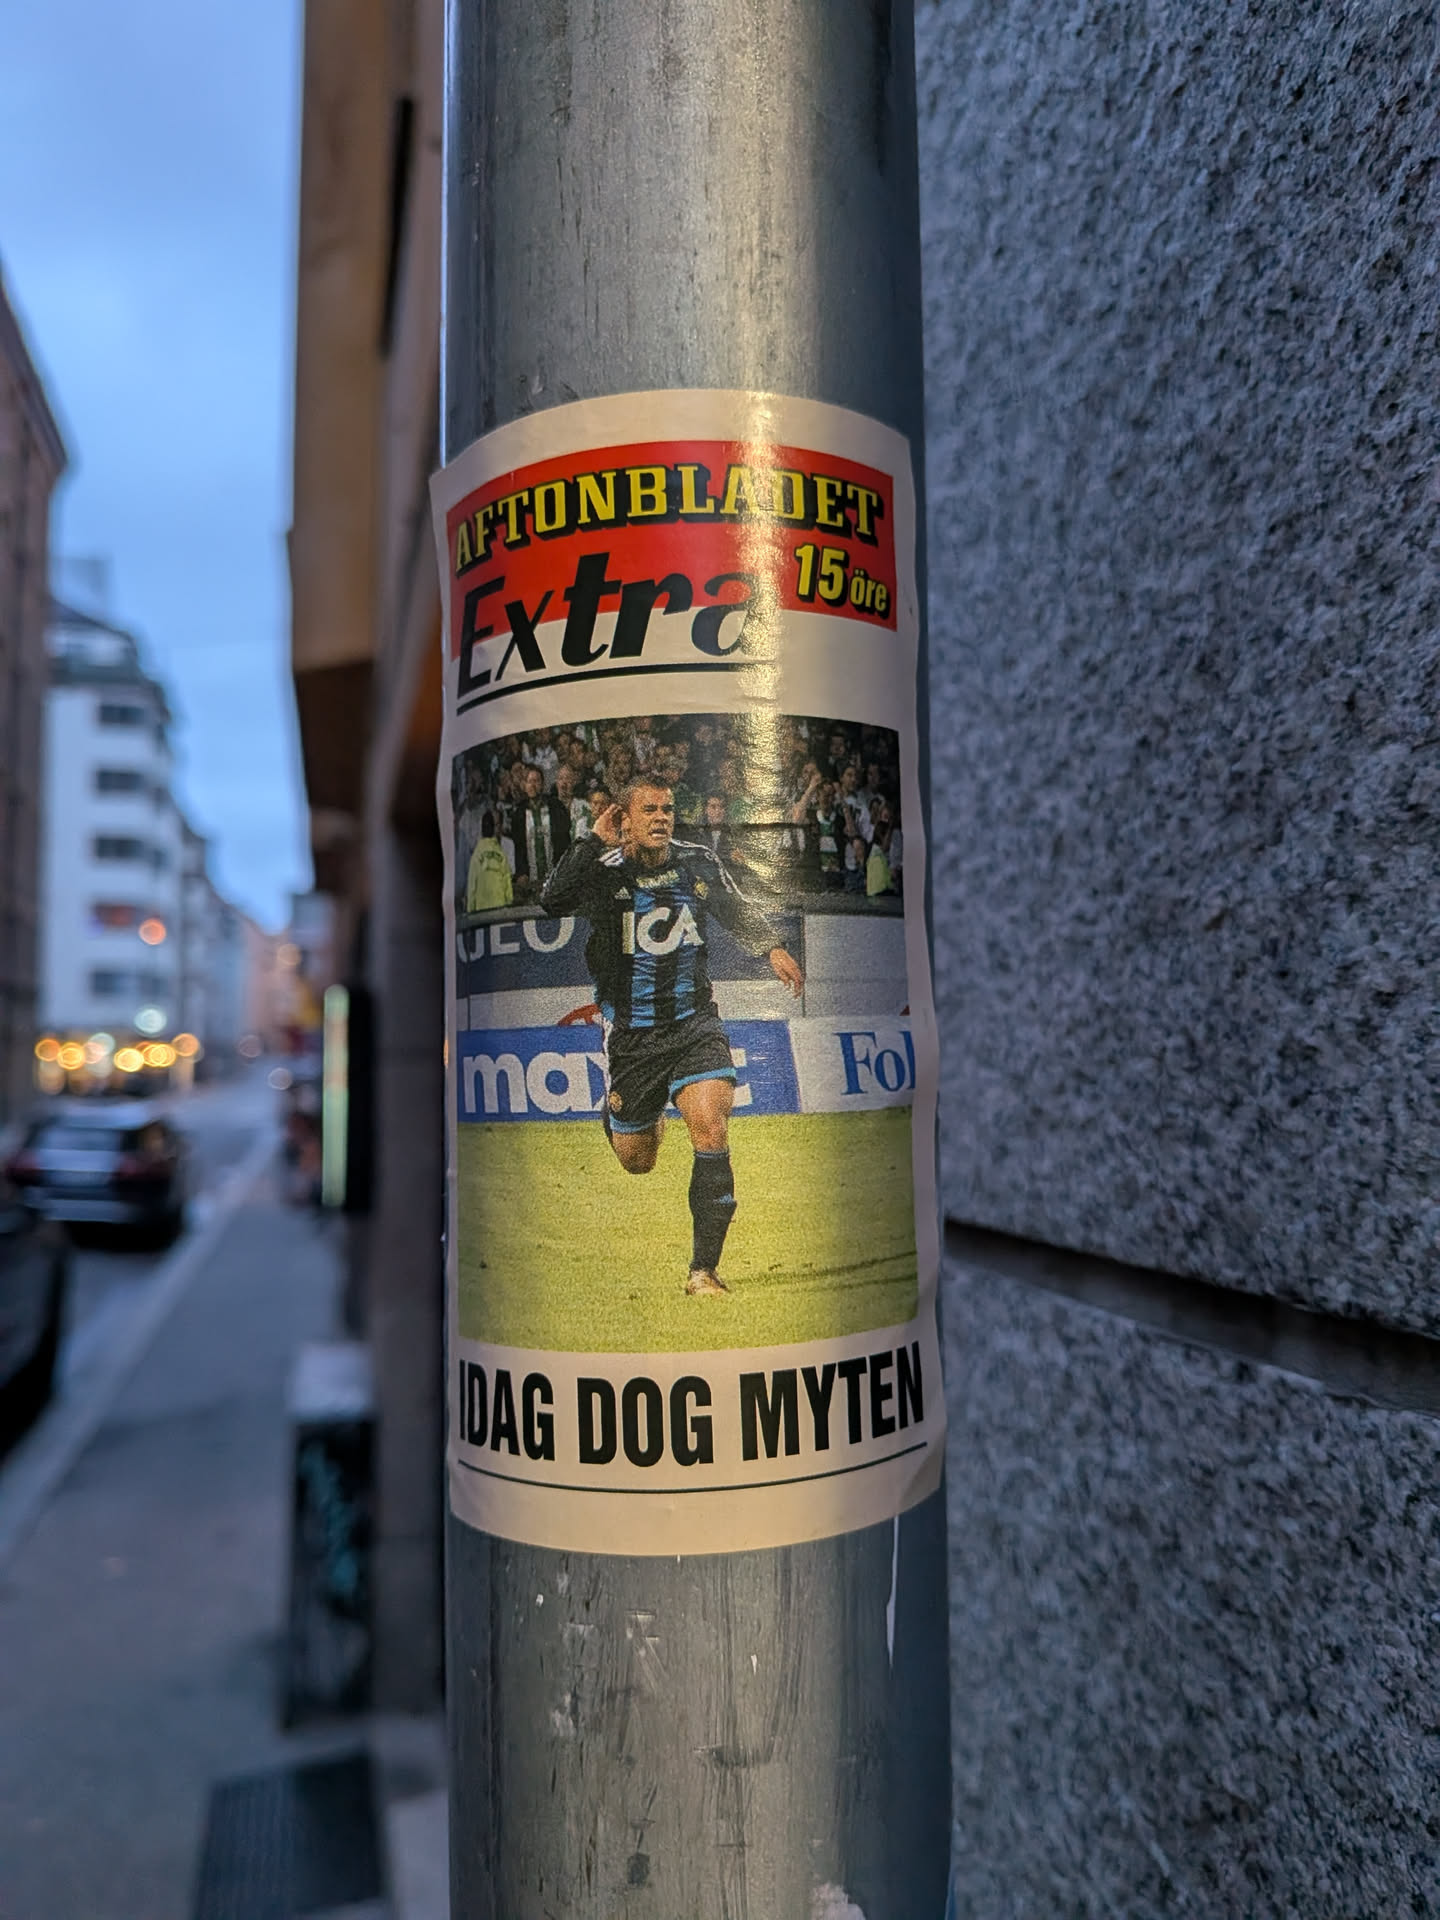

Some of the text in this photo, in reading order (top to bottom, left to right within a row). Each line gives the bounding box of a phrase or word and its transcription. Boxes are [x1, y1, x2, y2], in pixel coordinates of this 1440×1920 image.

[455, 463, 882, 576] AFTONBLADET
[457, 551, 765, 699] Extra
[795, 544, 888, 615] 15 öre
[622, 902, 704, 955] ICA
[460, 1341, 925, 1467] IDAG DOG MYTEN
